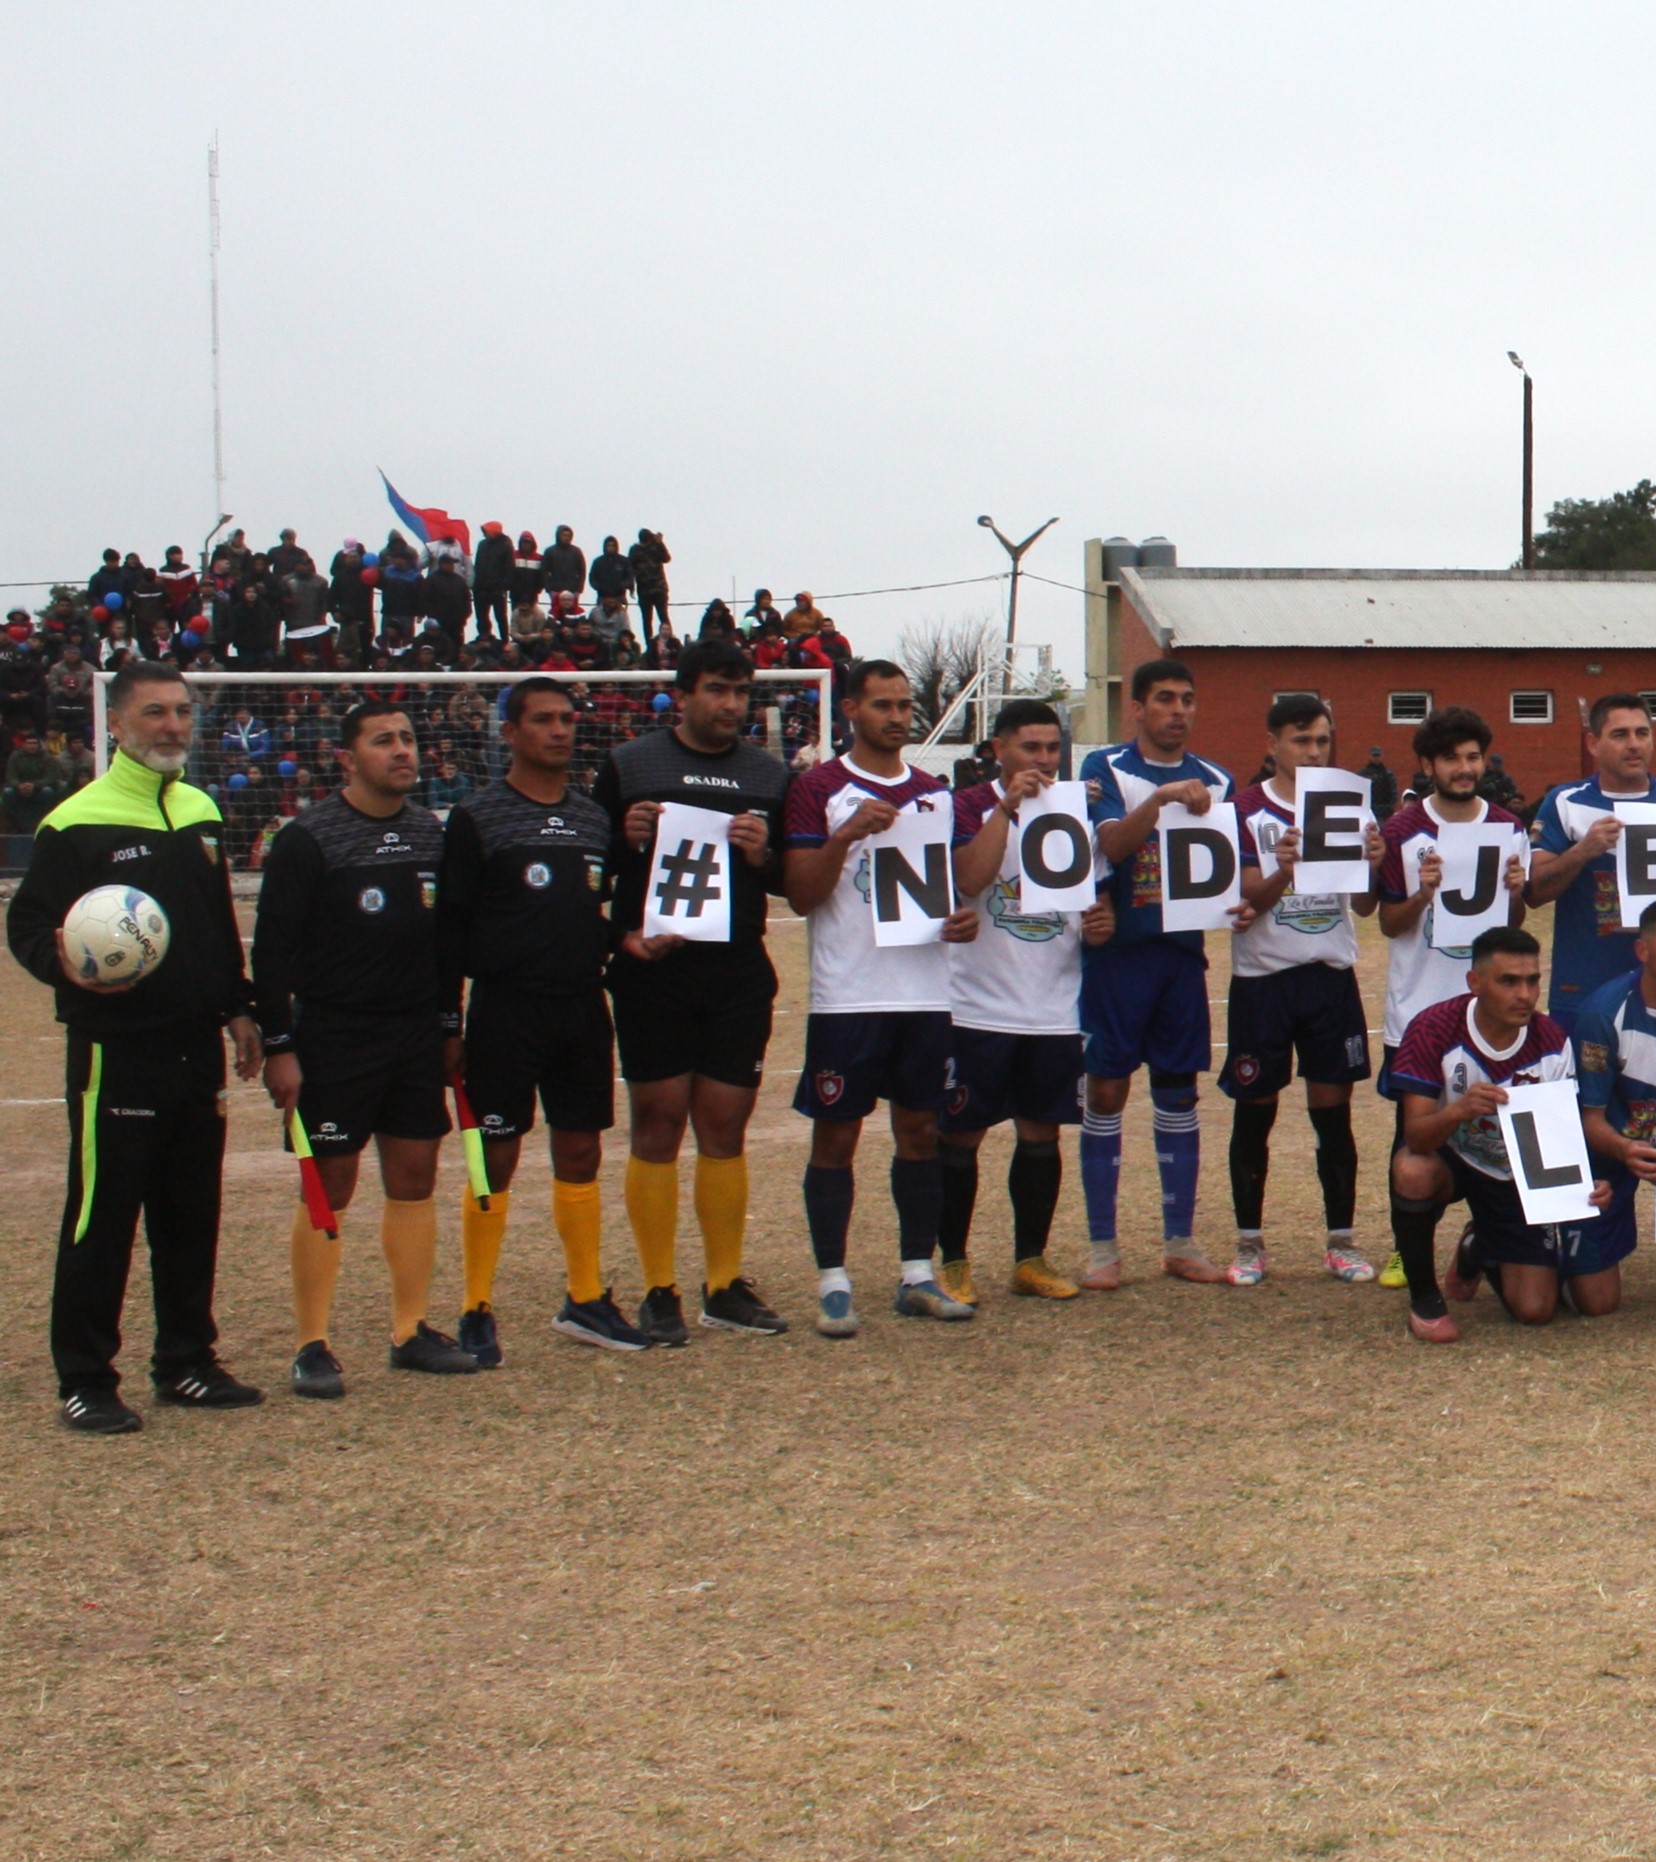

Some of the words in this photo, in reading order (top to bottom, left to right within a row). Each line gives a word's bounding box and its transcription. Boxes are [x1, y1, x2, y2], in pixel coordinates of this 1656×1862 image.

[112, 847, 138, 863] JOSE
[140, 845, 152, 856] R.
[1020, 812, 1092, 890] O
[1302, 791, 1363, 862] E
[655, 838, 722, 918] #
[874, 843, 951, 923] N
[1166, 828, 1236, 901] D
[1441, 845, 1500, 916] J
[118, 916, 159, 961] PENALTY
[943, 1057, 957, 1090] 2
[1511, 1111, 1583, 1190] L
[1567, 1230, 1582, 1257] 7
